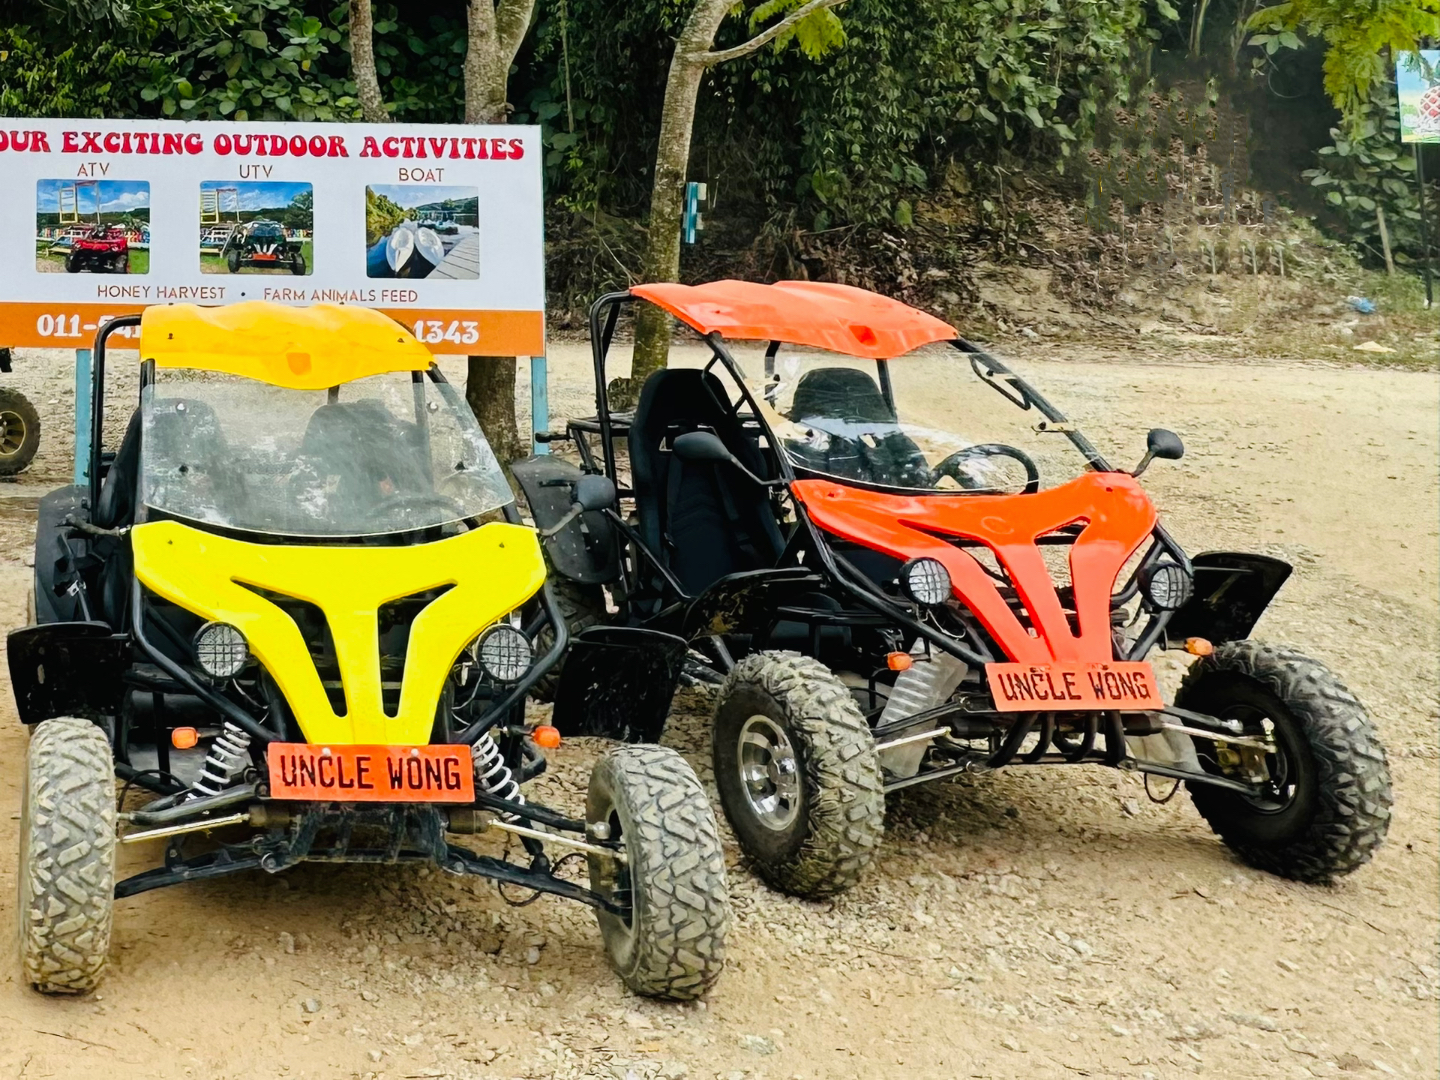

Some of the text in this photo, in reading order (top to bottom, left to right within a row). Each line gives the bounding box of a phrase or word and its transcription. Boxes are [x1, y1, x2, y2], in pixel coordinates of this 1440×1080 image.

[61, 131, 203, 155] EXCITING
[213, 133, 349, 157] OUTDOOR
[359, 135, 525, 160] ACTIVITIES
[77, 162, 111, 177] ATV
[239, 164, 273, 179] UTV
[398, 168, 445, 182] BOAT
[97, 285, 226, 300] HONEY HARVEST
[263, 287, 418, 303] FARM ANIMALS FEED
[414, 320, 480, 344] 1343
[998, 671, 1152, 701] UNCLE WONG
[280, 755, 462, 790] UNCLE WONG
